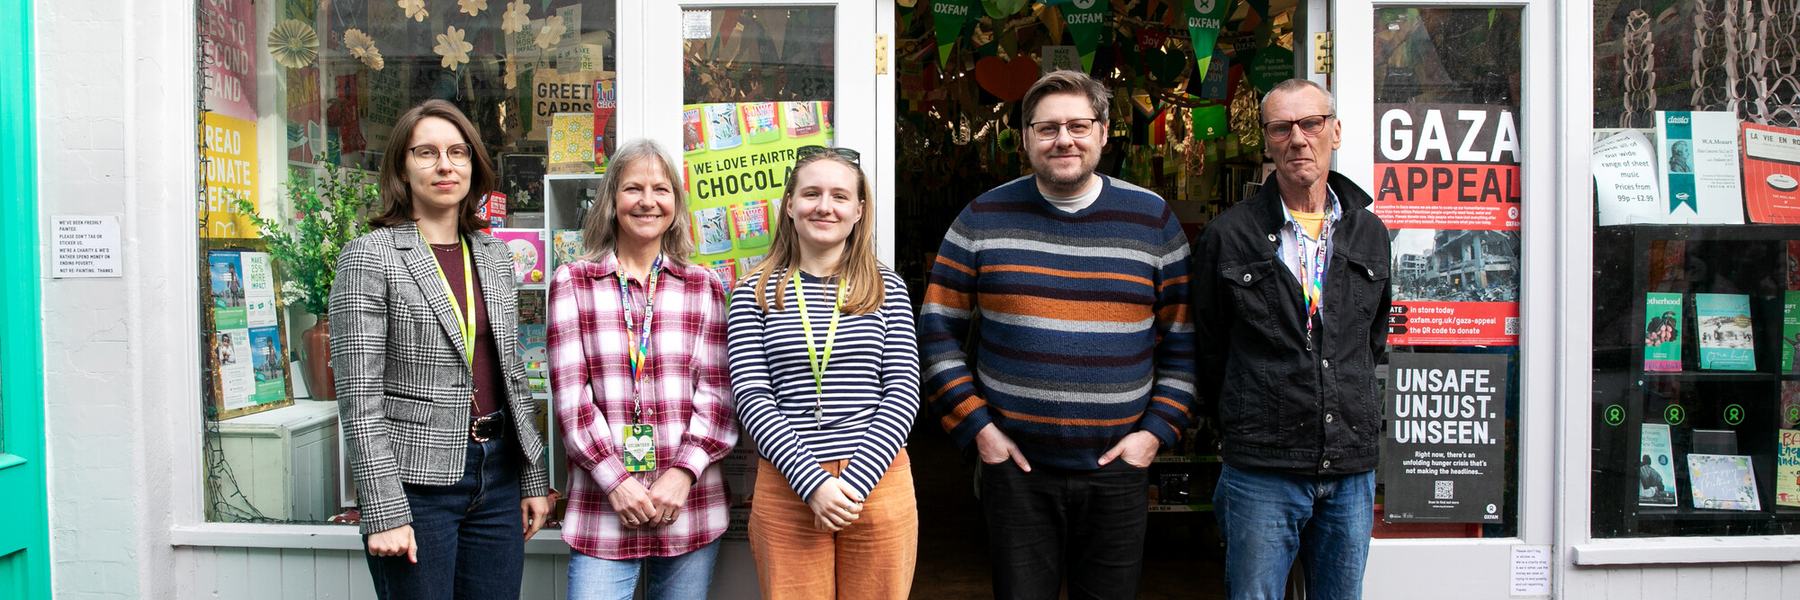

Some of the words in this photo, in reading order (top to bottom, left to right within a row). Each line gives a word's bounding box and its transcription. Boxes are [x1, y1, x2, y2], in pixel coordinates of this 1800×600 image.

[934, 2, 968, 16] OXFAM
[1068, 12, 1103, 24] OXFAM
[230, 17, 246, 46] TO
[1188, 16, 1220, 28] OXFAM
[204, 39, 249, 76] ECOND
[538, 82, 594, 100] GREET
[206, 124, 240, 156] READ
[1380, 109, 1520, 162] GAZA
[694, 162, 712, 176] WE
[716, 156, 747, 172] LOVE
[697, 165, 791, 200] CHOCOLA
[1377, 166, 1520, 203] APPEAL
[200, 186, 251, 214] EPET
[1410, 317, 1496, 325] oxfam.org.uk/gaza-appeal
[1436, 306, 1454, 315] today
[1396, 368, 1496, 393] UNSAFE.
[1396, 394, 1496, 418] UNJUST.
[1395, 420, 1496, 444] UNSEEN.
